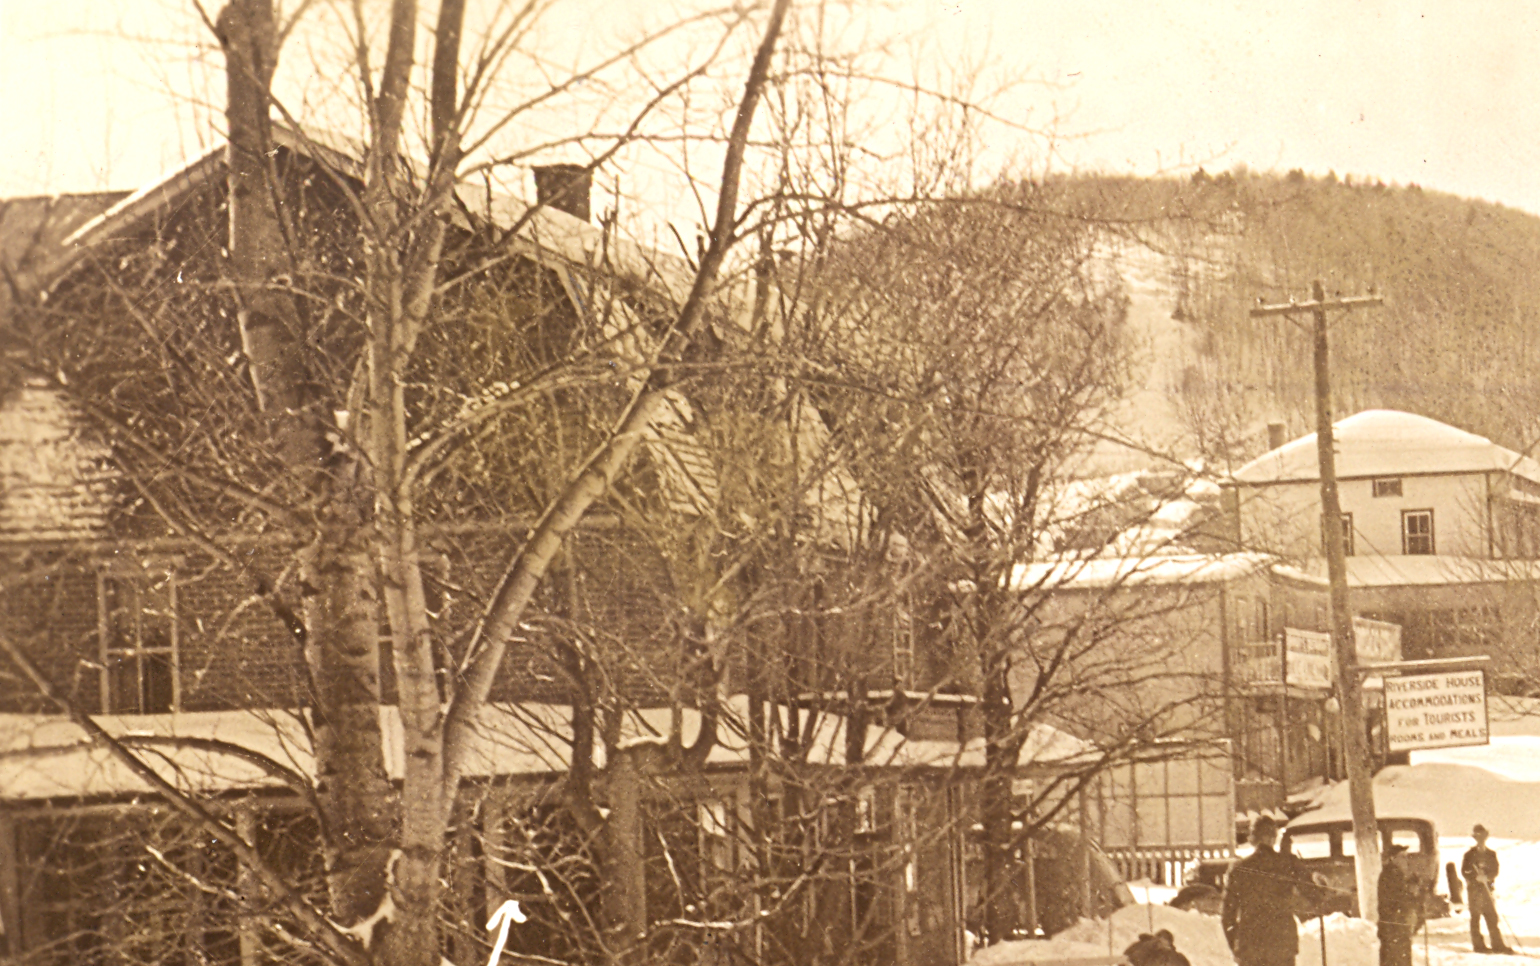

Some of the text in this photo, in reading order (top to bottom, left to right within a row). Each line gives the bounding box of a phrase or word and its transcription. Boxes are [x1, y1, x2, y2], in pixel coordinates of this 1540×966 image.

[1386, 677, 1483, 692] RIVERSIDE HOUSE
[1389, 693, 1481, 709] ACCOMMODATIONS
[1398, 711, 1475, 727] FOR TOURISTS
[1450, 728, 1487, 739] MEALS
